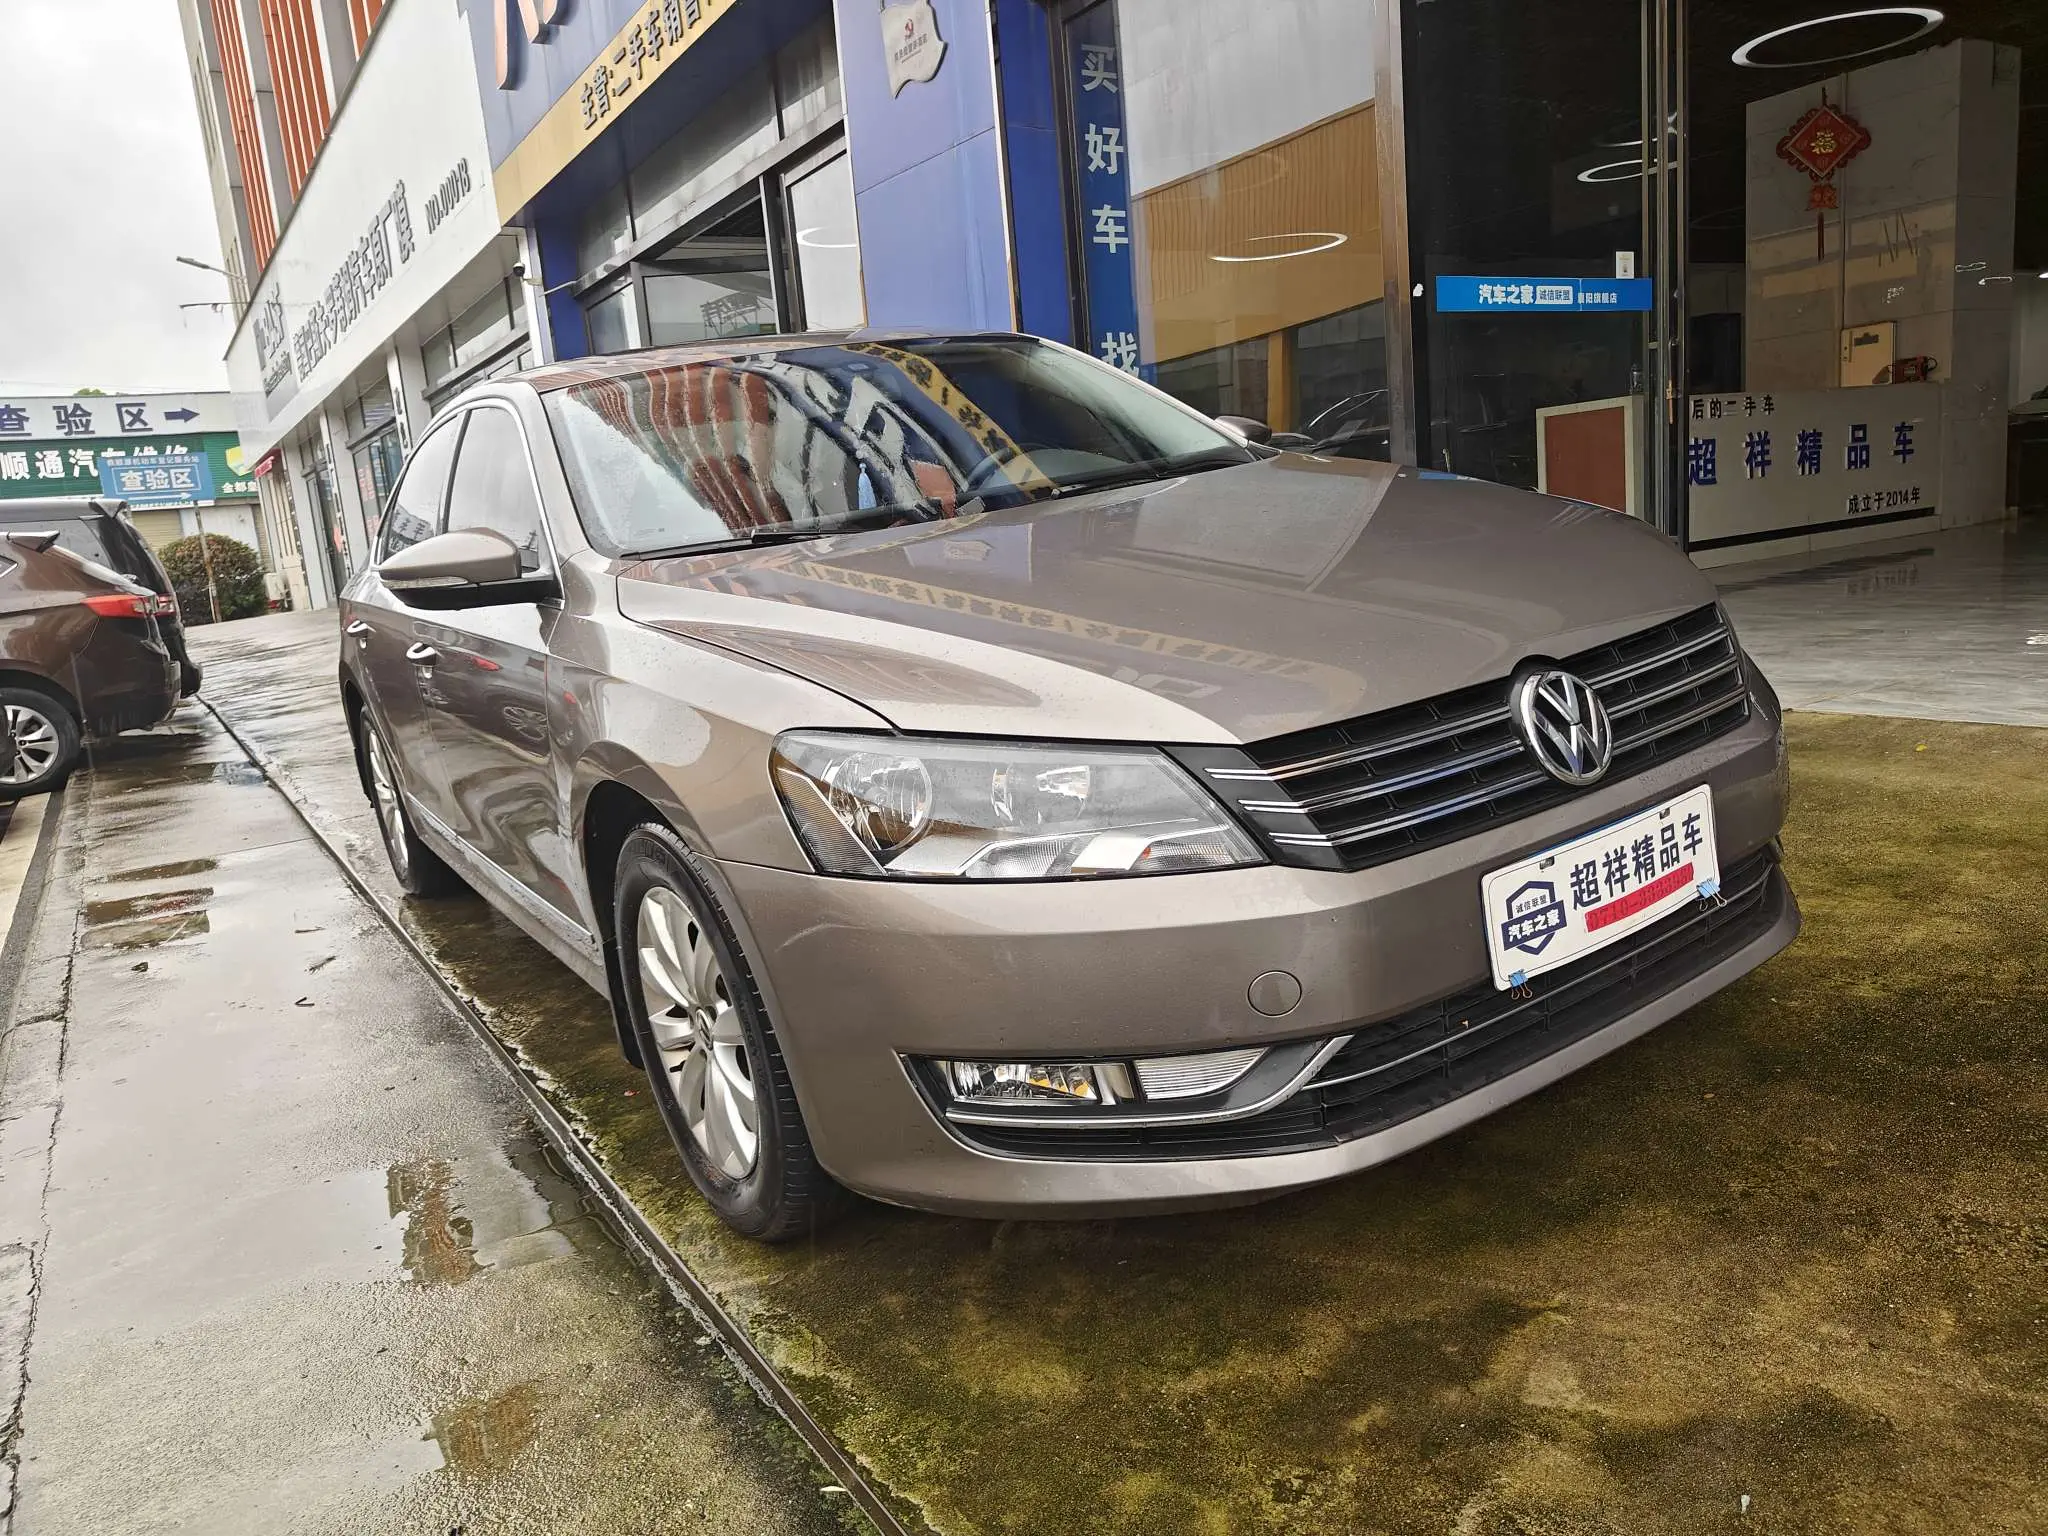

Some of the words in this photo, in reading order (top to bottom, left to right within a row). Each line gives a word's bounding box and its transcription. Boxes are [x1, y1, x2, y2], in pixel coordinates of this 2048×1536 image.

[1478, 284, 1534, 305] 汽车之家
[0, 402, 153, 437] 查验区
[1691, 394, 1775, 420] 后的二手车
[1688, 421, 1915, 487] 超祥精品车
[120, 468, 195, 492] 查验区
[1847, 486, 1921, 514] 成立于2014年
[1570, 812, 1703, 911] 超祥精品车
[1508, 908, 1560, 942] 汽车之家
